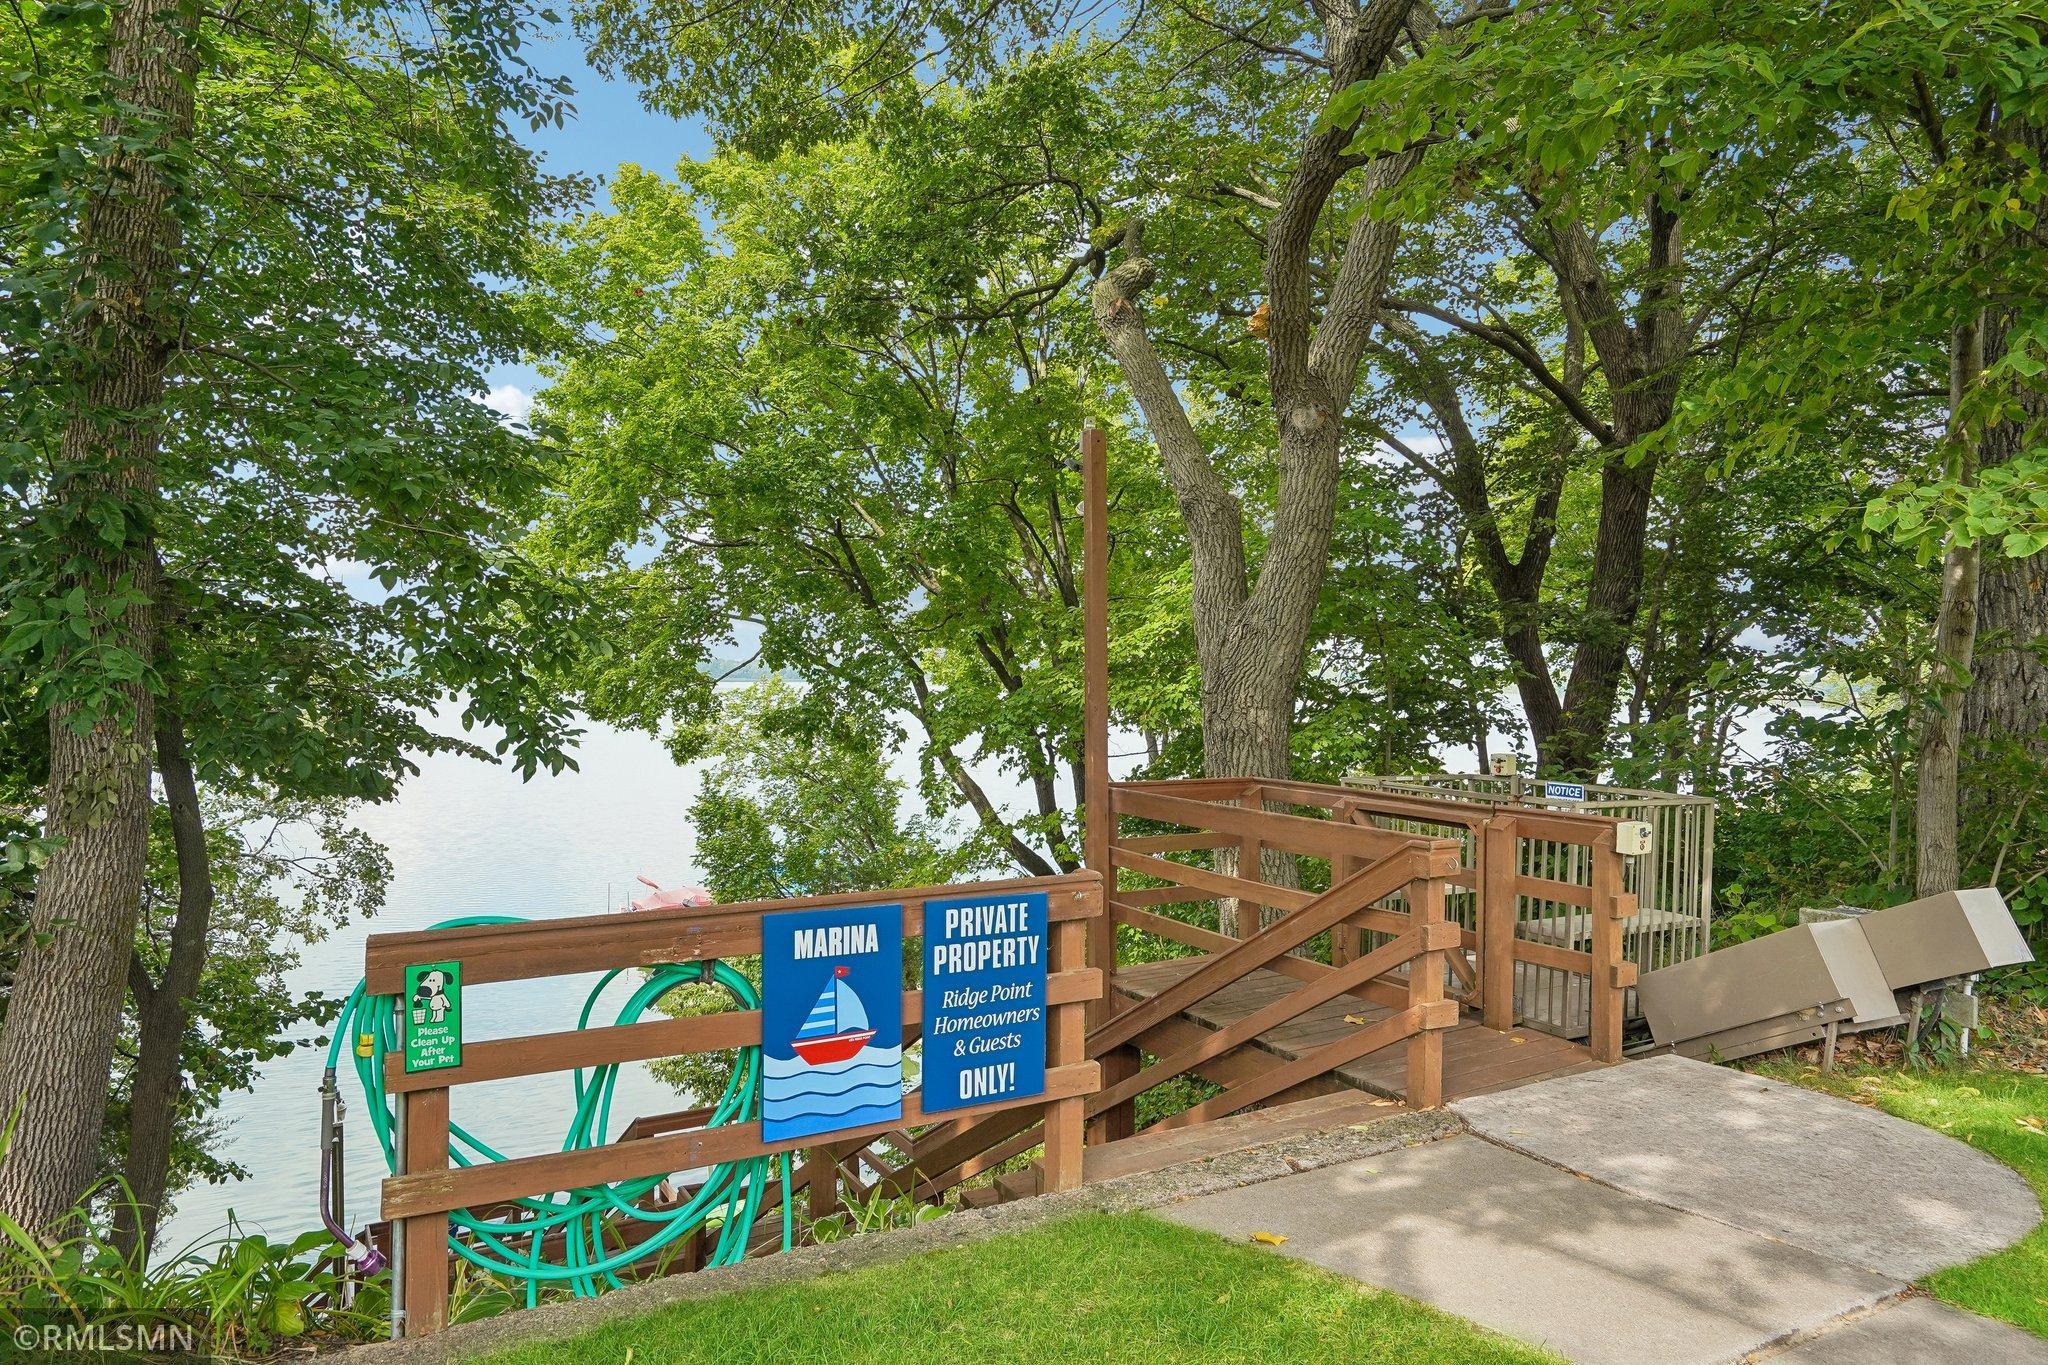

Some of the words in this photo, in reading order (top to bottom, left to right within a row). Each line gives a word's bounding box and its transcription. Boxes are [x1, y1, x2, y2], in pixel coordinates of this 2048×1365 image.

[1548, 785, 1581, 797] NOTICE
[945, 902, 1028, 939] PRIVATE
[794, 923, 879, 960] MARINA
[934, 935, 1040, 975] PROPERTY
[942, 987, 988, 1010] Ridge
[990, 981, 1033, 1003] Point
[418, 1026, 448, 1037] Please
[933, 1007, 1041, 1035] Homeowners
[411, 1038, 438, 1047] Clean
[441, 1036, 455, 1045] Up
[421, 1046, 445, 1056] After
[953, 1039, 966, 1057] &
[969, 1032, 1022, 1054] Guests
[412, 1058, 435, 1067] Your
[438, 1055, 454, 1064] Pet
[960, 1062, 1015, 1100] ONLY!
